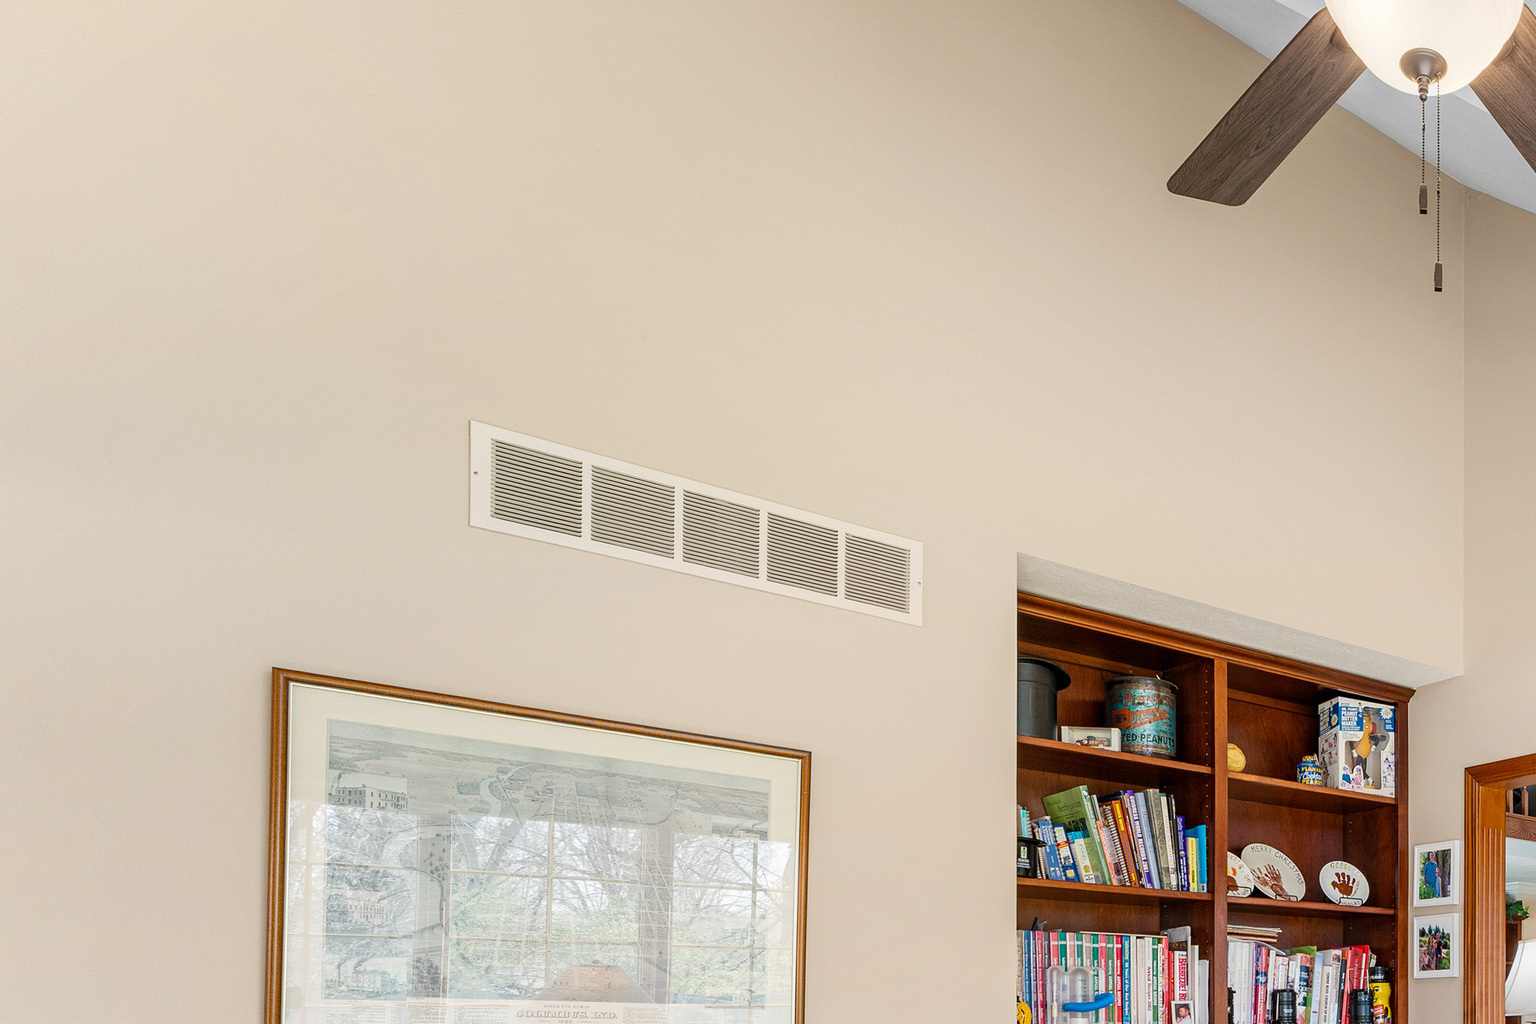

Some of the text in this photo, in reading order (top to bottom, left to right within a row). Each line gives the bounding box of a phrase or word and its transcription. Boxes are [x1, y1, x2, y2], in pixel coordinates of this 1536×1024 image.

[1140, 734, 1175, 747] PEANUTS
[1129, 795, 1139, 820] GUINNESS
[1134, 820, 1142, 838] WORLD
[1137, 838, 1146, 861] RECORDS
[1250, 845, 1273, 854] MERRY
[515, 1009, 619, 1020] COLUMBUS, IND.
